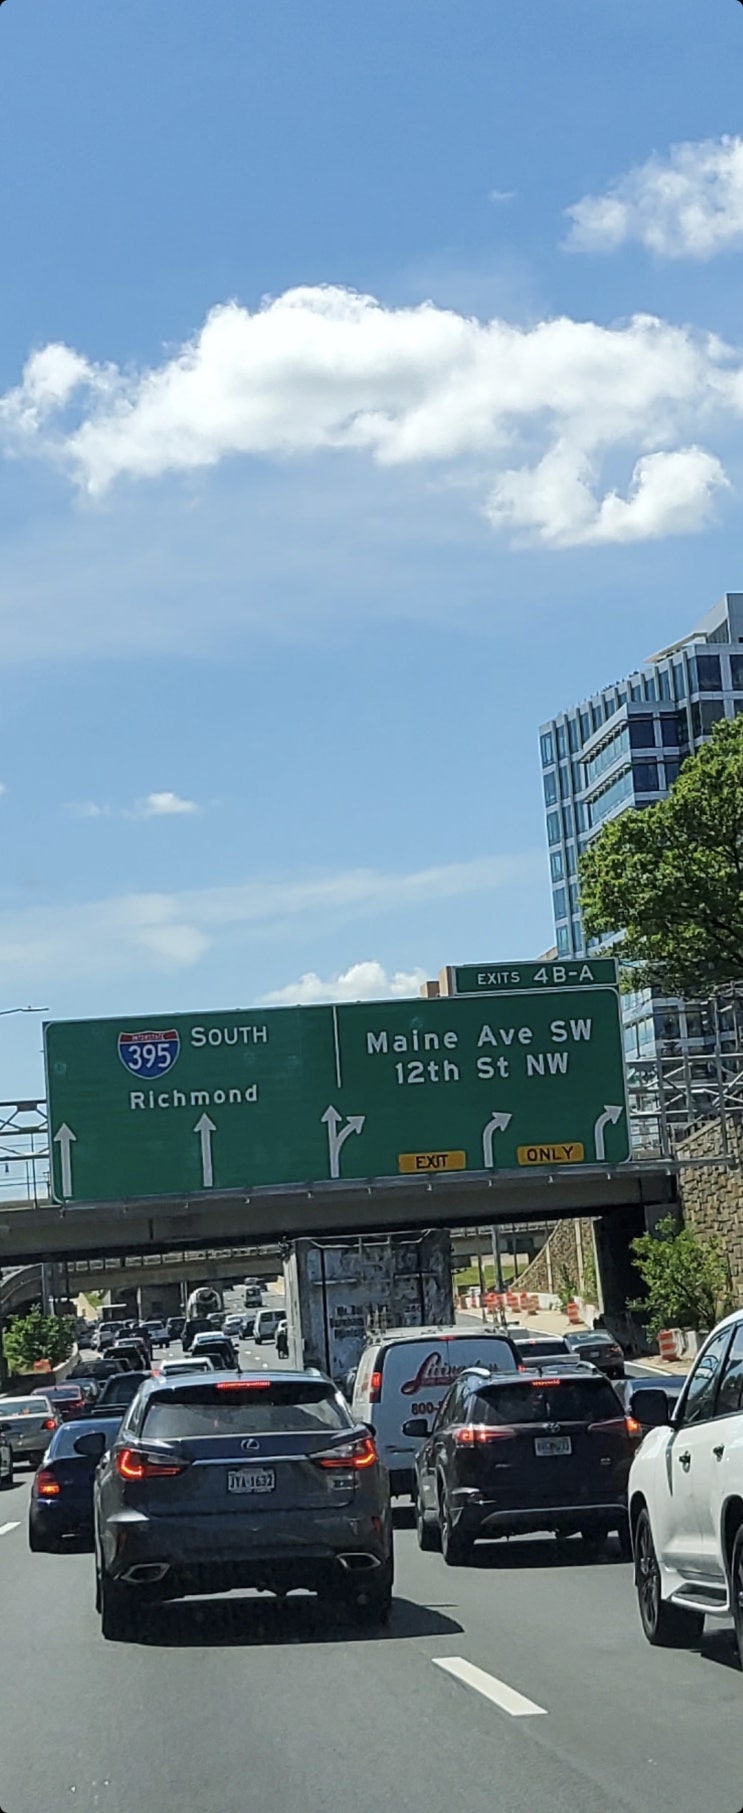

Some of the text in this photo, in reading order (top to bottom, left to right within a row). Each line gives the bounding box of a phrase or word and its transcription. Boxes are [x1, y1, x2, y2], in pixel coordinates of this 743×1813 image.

[477, 965, 594, 985] EXITS 4B-A
[190, 1026, 268, 1047] SOUTH
[366, 1018, 592, 1054] Maine Ave SW
[128, 1043, 172, 1070] 395
[395, 1052, 568, 1084] 12th St NW
[129, 1084, 259, 1109] Richmond
[415, 1145, 574, 1169] EXIT ONLY
